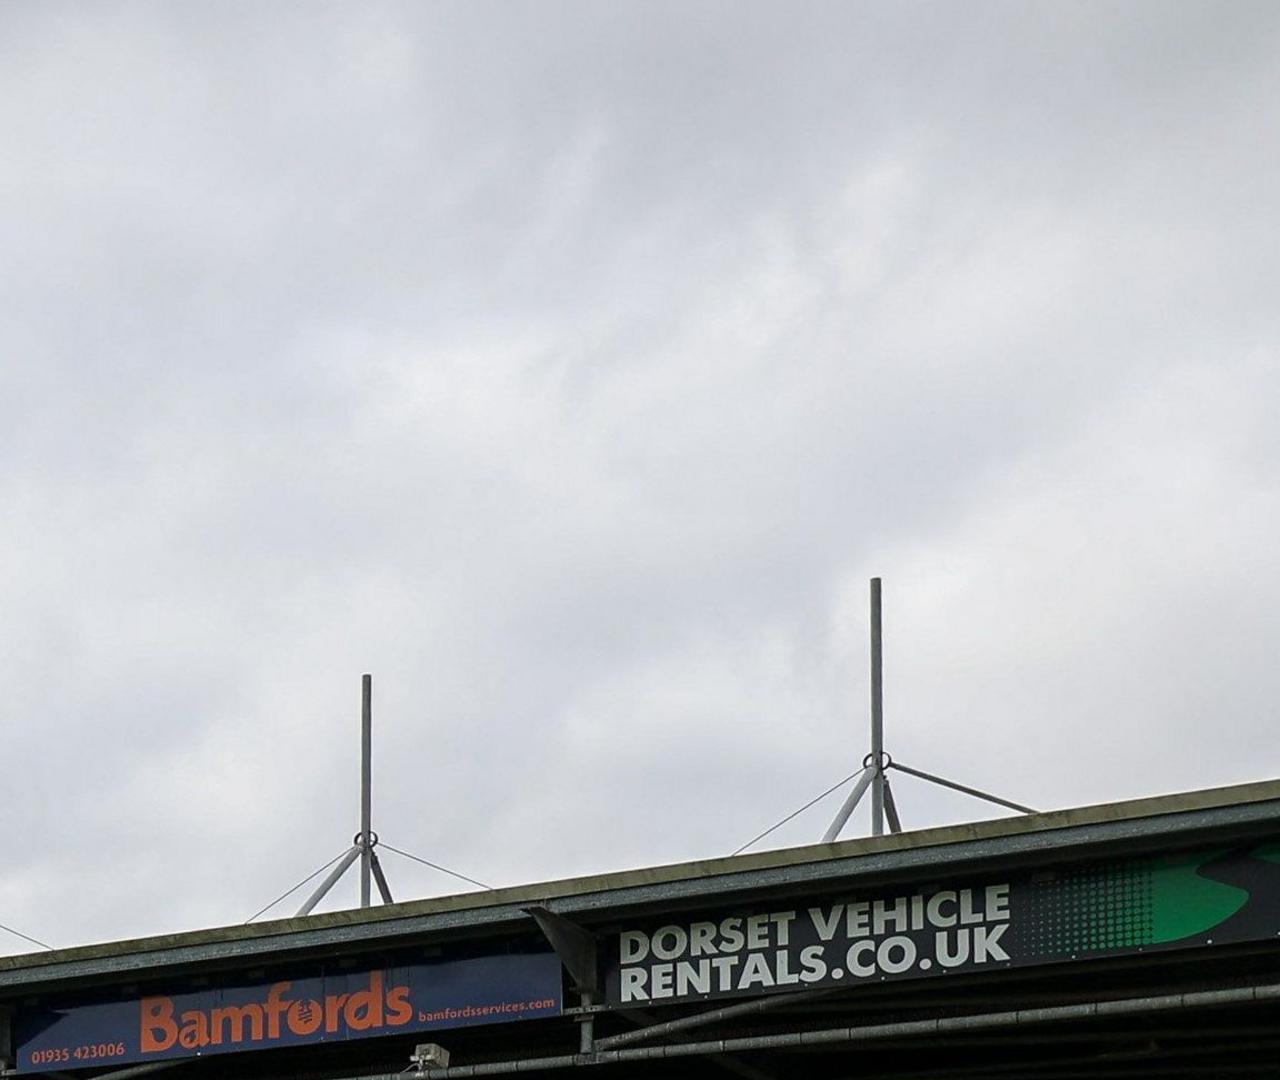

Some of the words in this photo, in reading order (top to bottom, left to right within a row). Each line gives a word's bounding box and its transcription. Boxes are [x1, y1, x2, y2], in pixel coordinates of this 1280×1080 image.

[620, 910, 796, 966] DORSET
[808, 884, 1011, 942] VEHICLE
[621, 923, 1012, 1003] RENTALS.CO.UK
[141, 970, 414, 1053] Bamfords
[418, 999, 556, 1023] bamfordsservices.com
[31, 1047, 70, 1066] 01935
[73, 1042, 126, 1061] 423006
